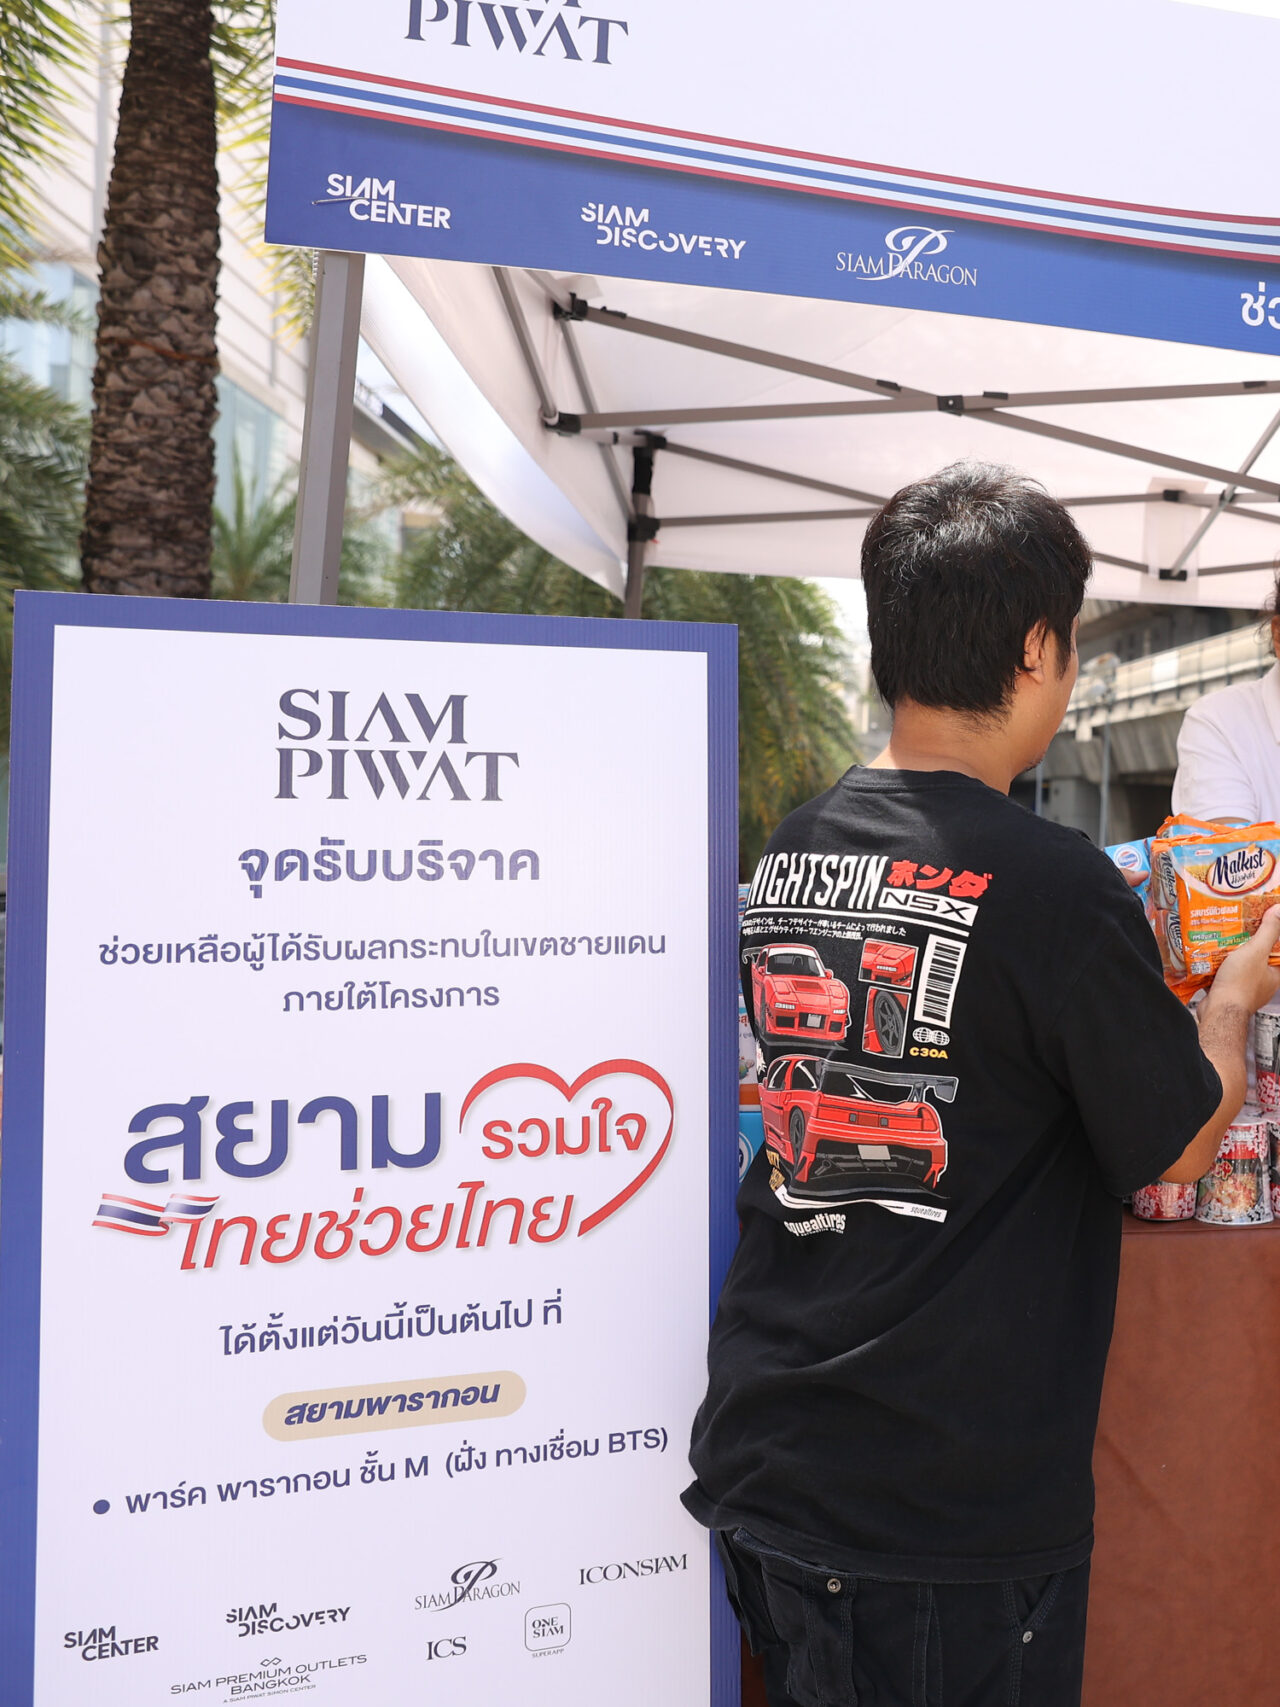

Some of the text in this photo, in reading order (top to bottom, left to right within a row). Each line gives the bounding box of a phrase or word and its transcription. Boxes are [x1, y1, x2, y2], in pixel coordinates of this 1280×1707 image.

[404, 0, 629, 65] PIWAT
[326, 173, 396, 202] SIAM
[348, 200, 451, 230] CENTER
[580, 202, 649, 228] SIAM
[596, 226, 747, 260] DISCOVERY
[277, 688, 469, 744] SIAM
[274, 747, 521, 801] PIWAT
[237, 836, 541, 900] จุดรับบริจาค
[746, 852, 993, 911] NIGHTSPIN ホンダ
[1212, 847, 1265, 890] Malkist
[881, 889, 970, 921] NSX
[98, 928, 667, 972] ช่วยเหลือผู้ได้รับผลกระทบในเขตชายแดน
[282, 980, 500, 1014] ภายใต้โครงการ
[909, 1046, 949, 1060] C30A
[123, 1092, 648, 1184] สยาม รวมใจ
[179, 1180, 575, 1270] ไทยช่วยไทย
[219, 1289, 564, 1356] ได้ตั้งแต่วันนี้เป็นต้นไป ที่
[283, 1380, 502, 1426] สยามพารากอน
[125, 1427, 669, 1515] พาร์ค พารากอน ชั้น M (ฝั่ง ทางเชื่อม BTS)
[578, 1553, 689, 1586] ICONSIAM
[413, 1580, 521, 1611] SIAM PARAGON
[225, 1602, 278, 1624] SIAM
[238, 1606, 352, 1638] DISCOVERY
[531, 1616, 559, 1629] ONE
[63, 1625, 117, 1648] SIAM
[81, 1635, 160, 1662] CENTER
[425, 1636, 468, 1661] ICS
[532, 1625, 564, 1639] SIAM
[170, 1654, 368, 1695] SIAM PREMIUM OUTLETS
[230, 1674, 312, 1696] BANGKOK
